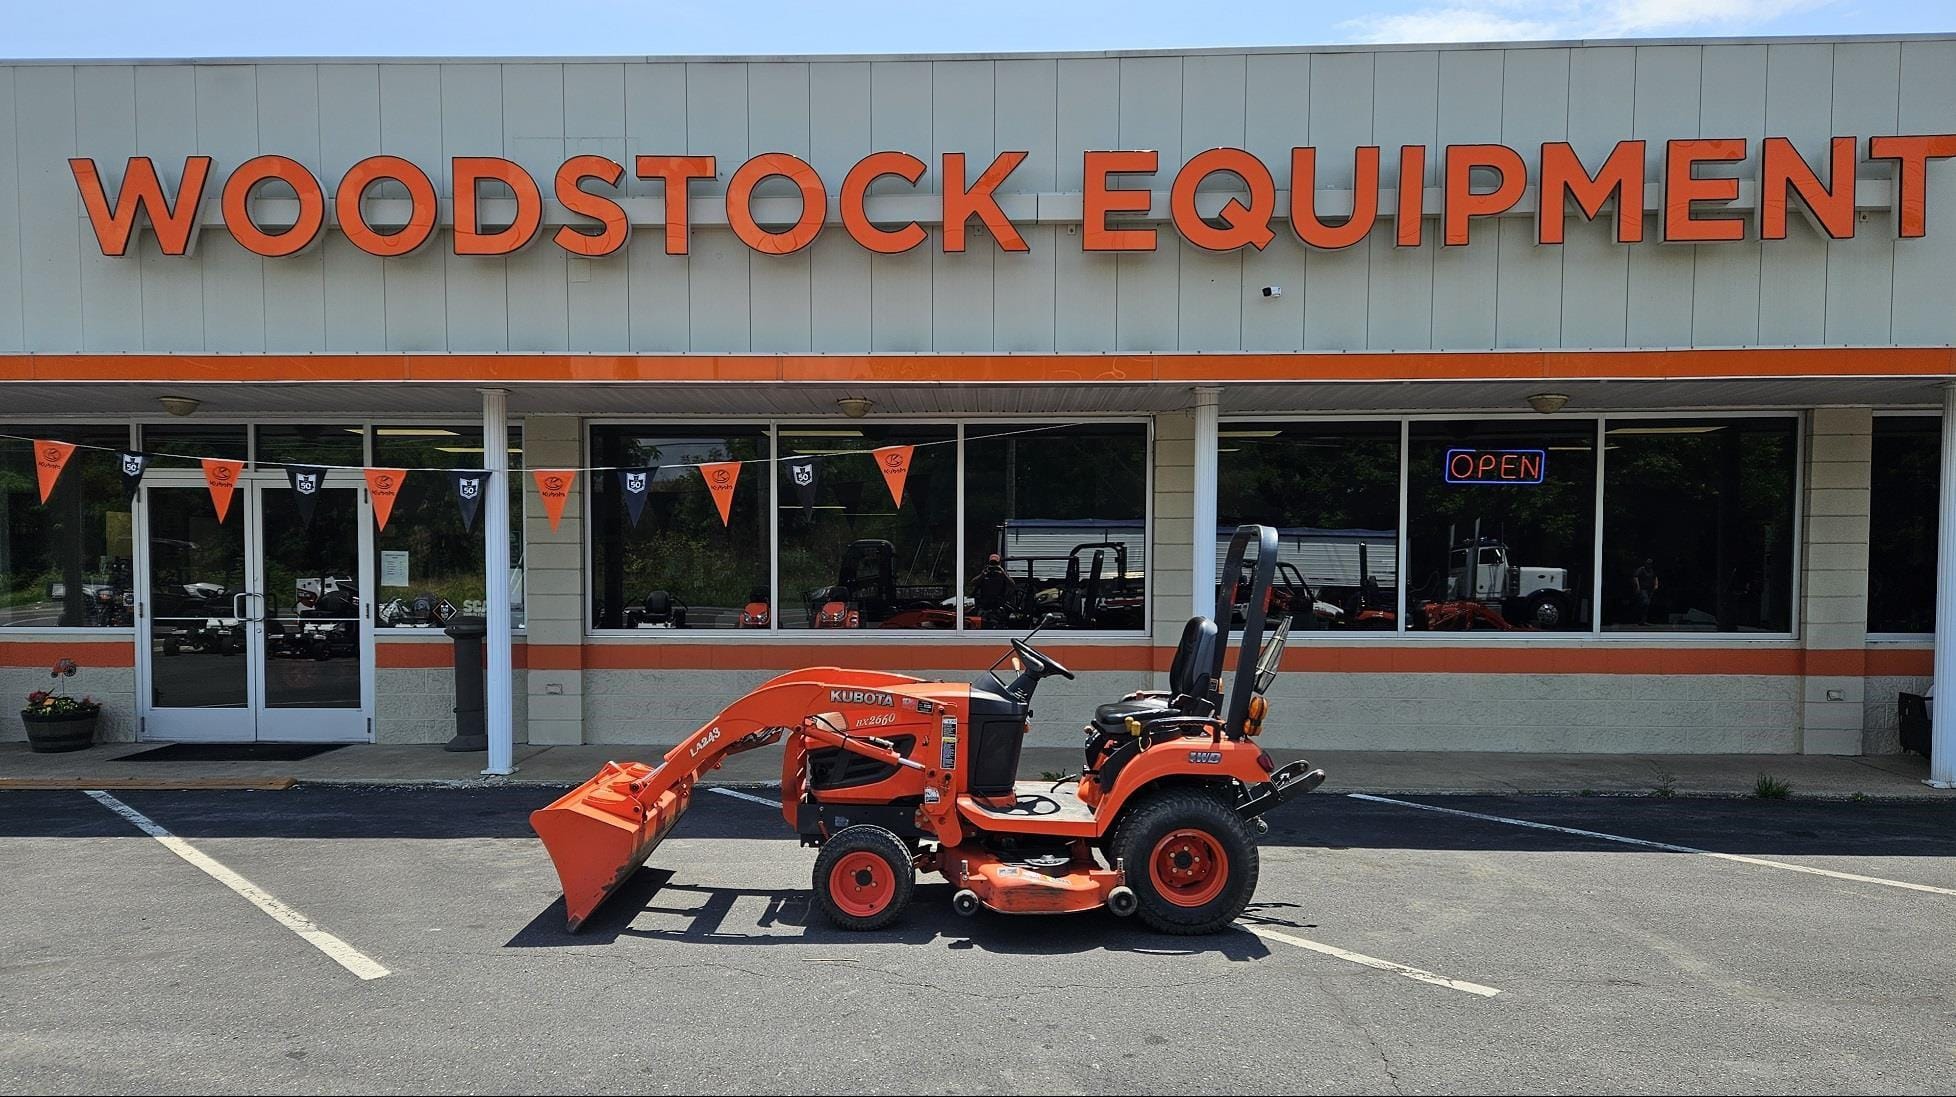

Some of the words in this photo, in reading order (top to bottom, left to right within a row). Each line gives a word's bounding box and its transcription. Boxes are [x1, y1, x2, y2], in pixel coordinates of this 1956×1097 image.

[68, 151, 1030, 258] WOODSTOCK
[1082, 133, 1956, 251] EQUIPMENT
[126, 463, 137, 472] 50
[1451, 454, 1540, 479] OPEN
[300, 482, 312, 490] 50
[630, 481, 641, 489] 50
[830, 689, 894, 707] KUBOTA
[689, 727, 721, 758] LA243
